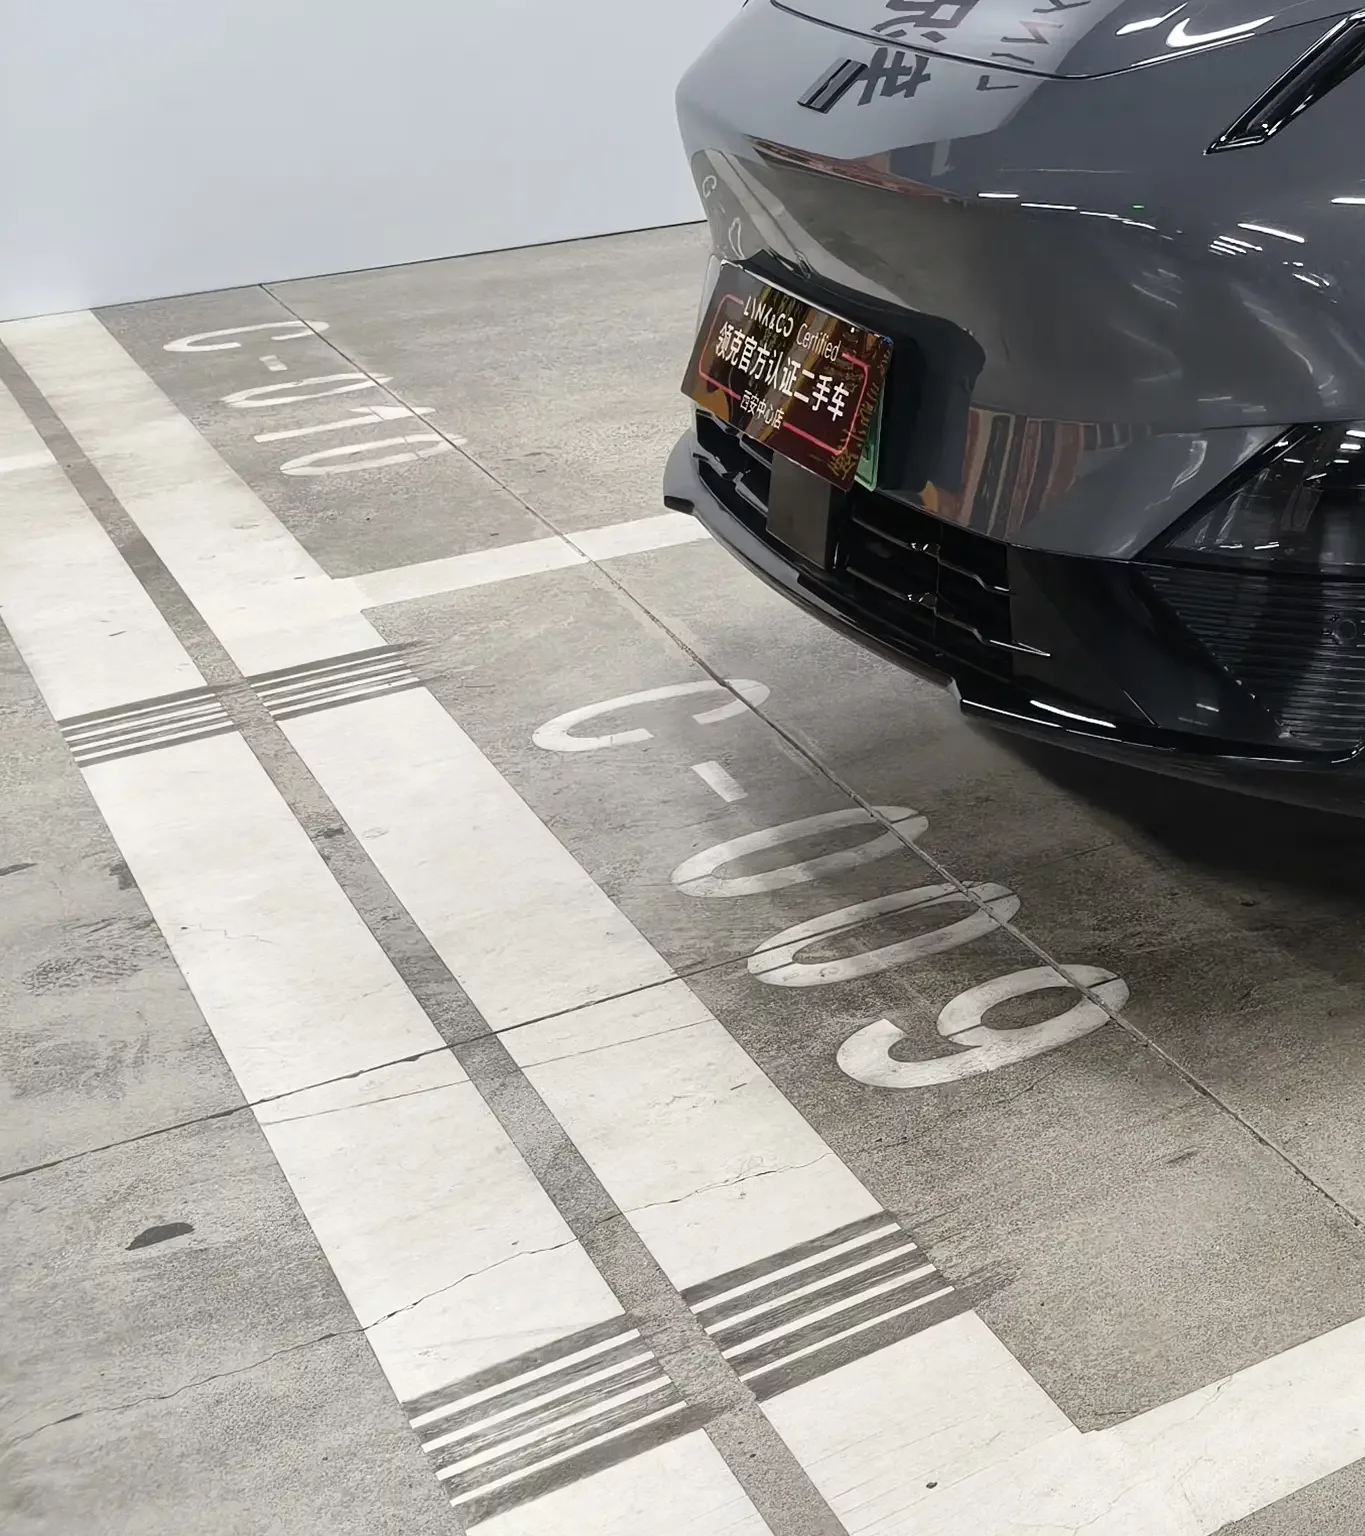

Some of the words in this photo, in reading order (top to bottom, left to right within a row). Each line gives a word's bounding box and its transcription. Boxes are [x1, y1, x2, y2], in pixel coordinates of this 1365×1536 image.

[715, 321, 850, 422] 领克官方认证二手车
[796, 323, 840, 362] Certified
[163, 320, 468, 476] C-010
[739, 390, 786, 431] 西安中心店
[531, 678, 1130, 1089] C-009
